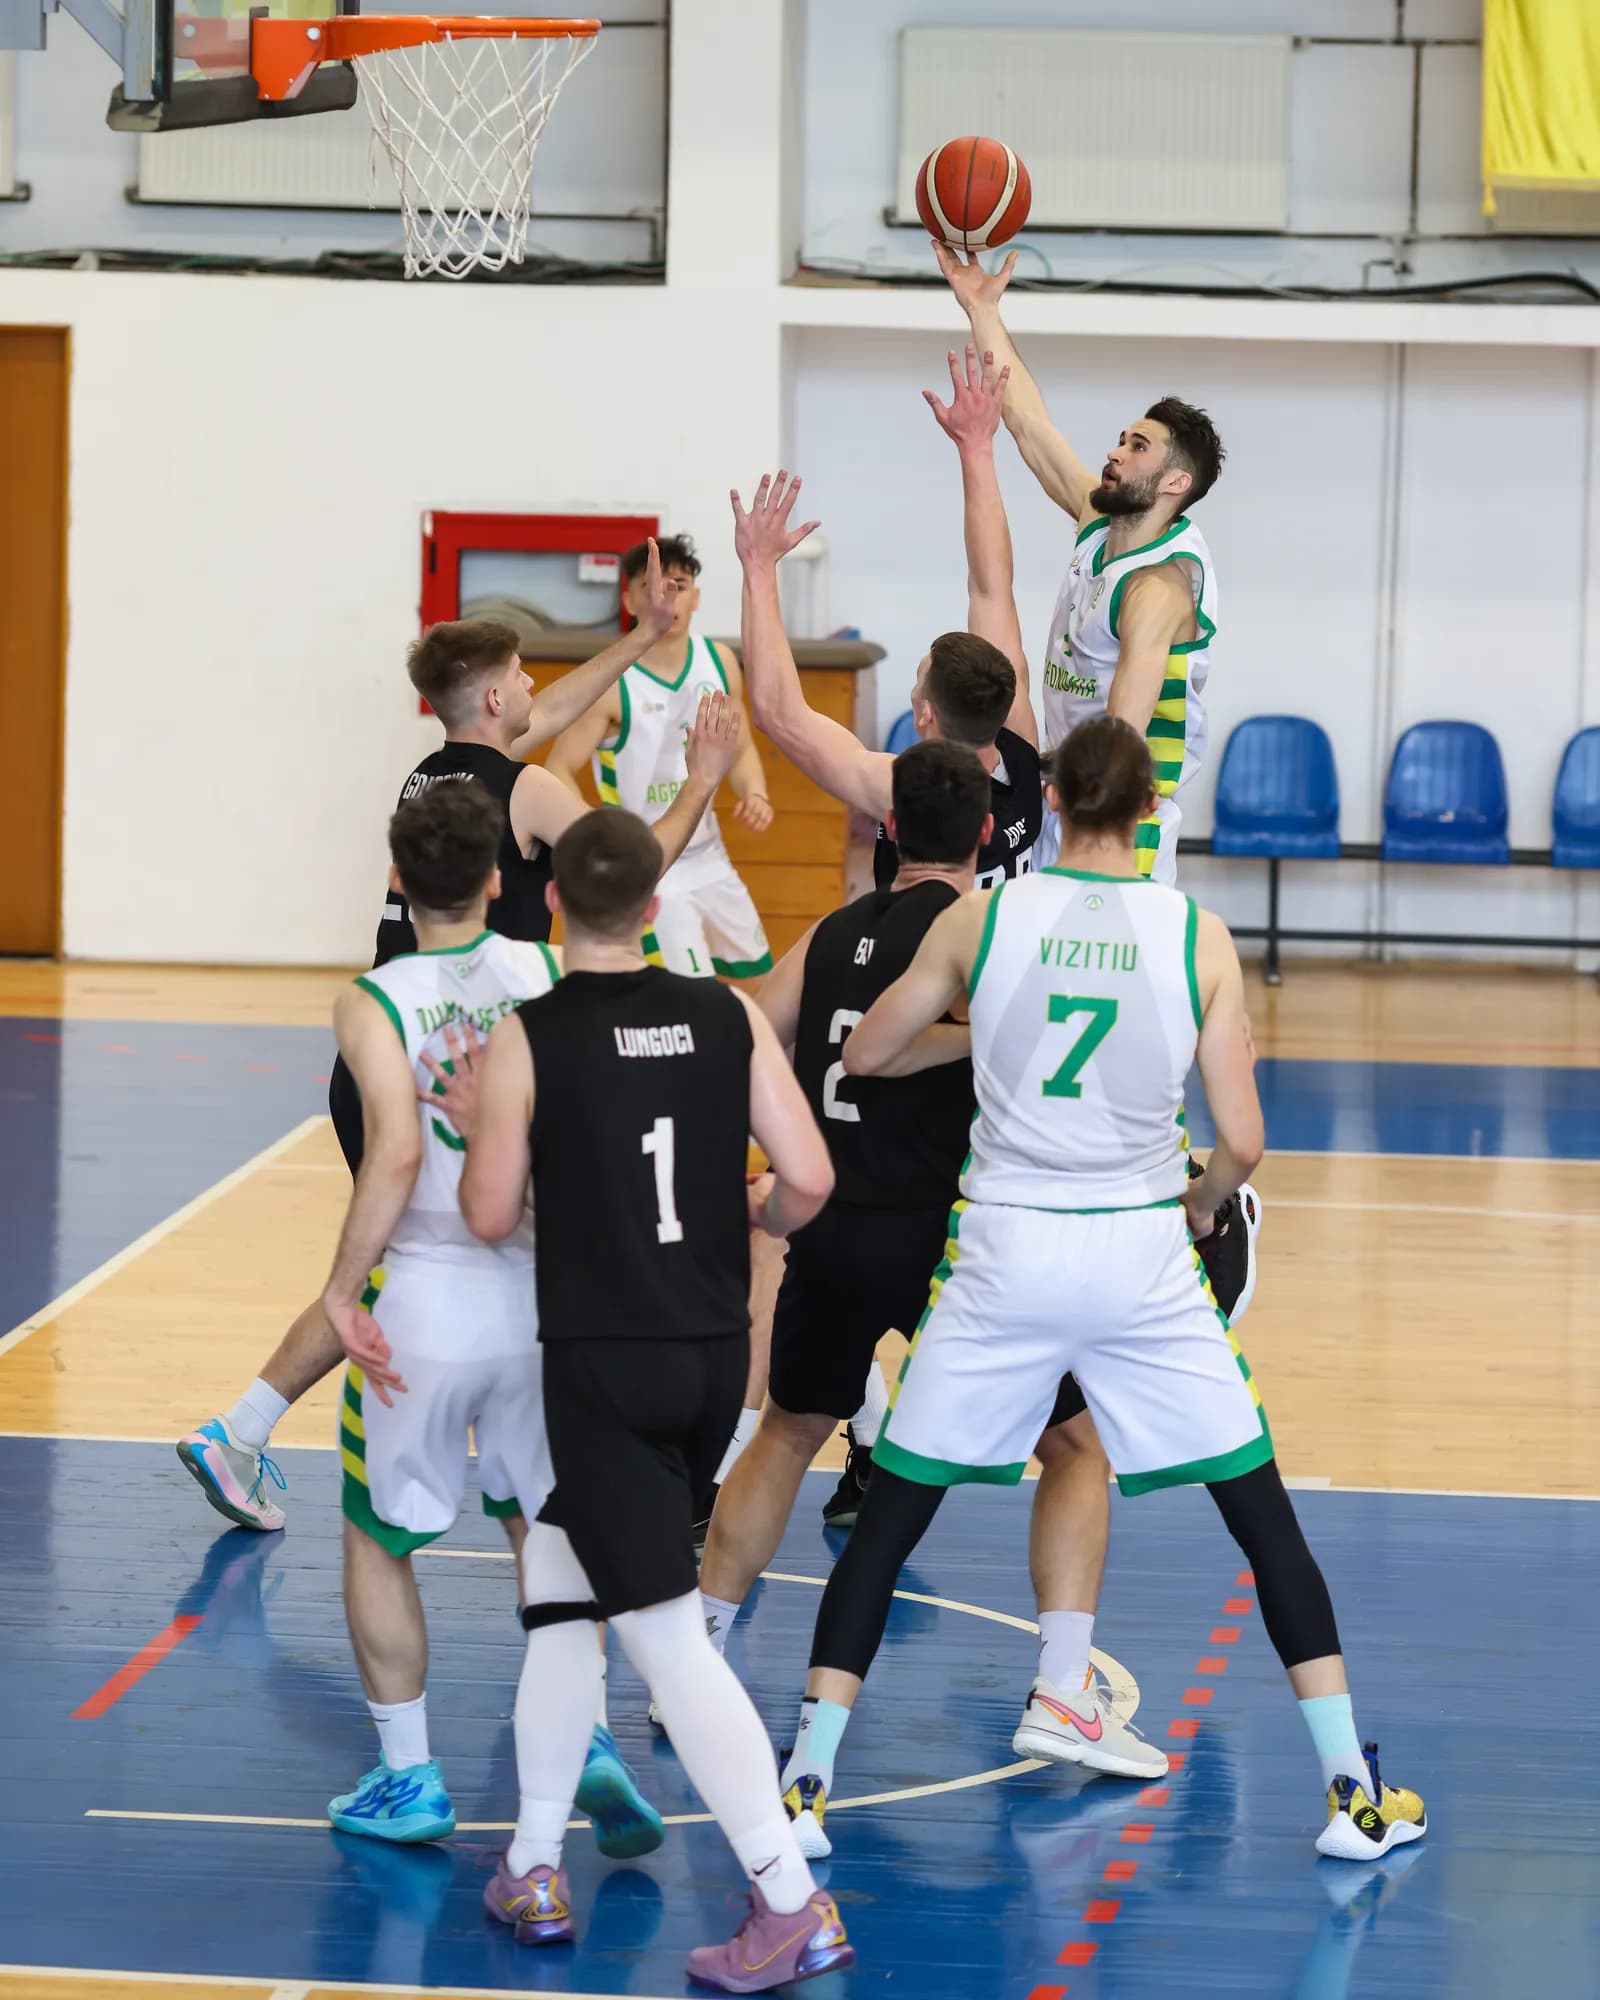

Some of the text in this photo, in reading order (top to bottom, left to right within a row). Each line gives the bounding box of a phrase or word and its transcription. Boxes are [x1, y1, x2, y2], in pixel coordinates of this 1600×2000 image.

[1041, 937, 1137, 972] VIZITIU
[614, 1024, 695, 1057] LUNGOCI
[1042, 994, 1118, 1098] 7
[642, 1117, 683, 1244] 1
